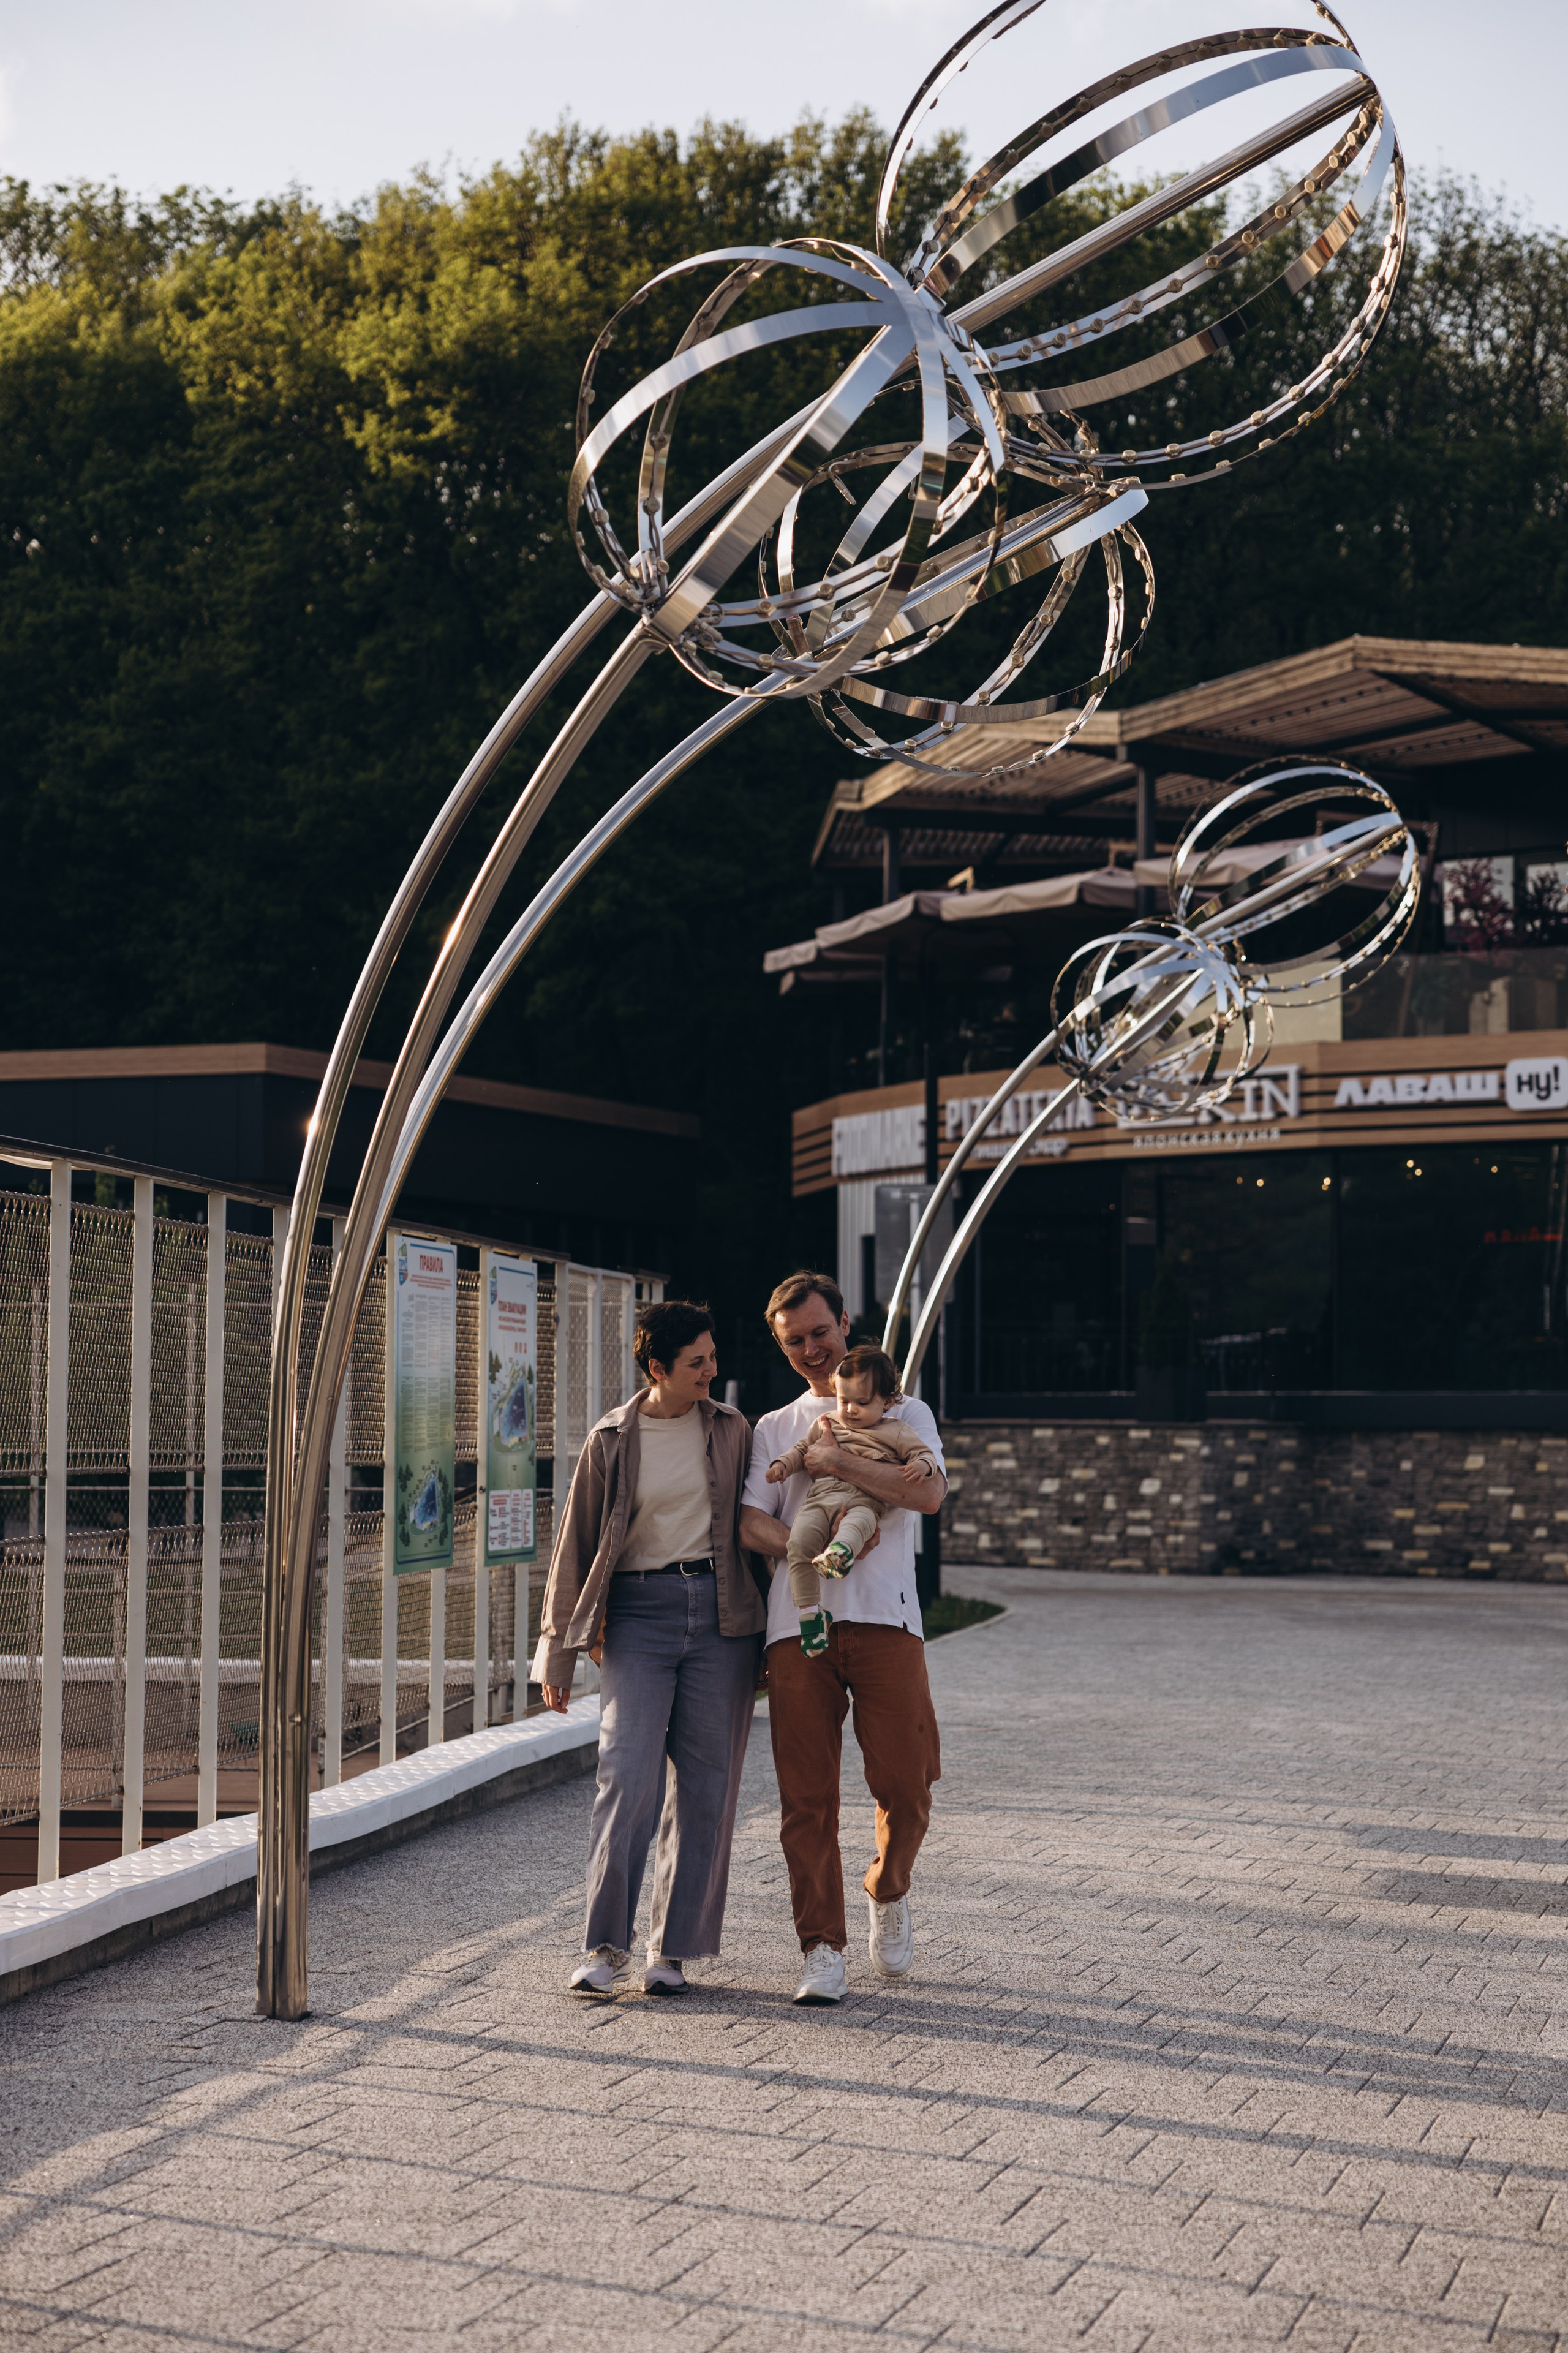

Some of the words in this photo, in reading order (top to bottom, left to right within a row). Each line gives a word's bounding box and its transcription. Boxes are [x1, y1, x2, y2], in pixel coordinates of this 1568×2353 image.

[1333, 1072, 1499, 1106] ЛАВАШ
[1224, 1127, 1281, 1149] кухня
[420, 1254, 443, 1273] ПРАВИЛА
